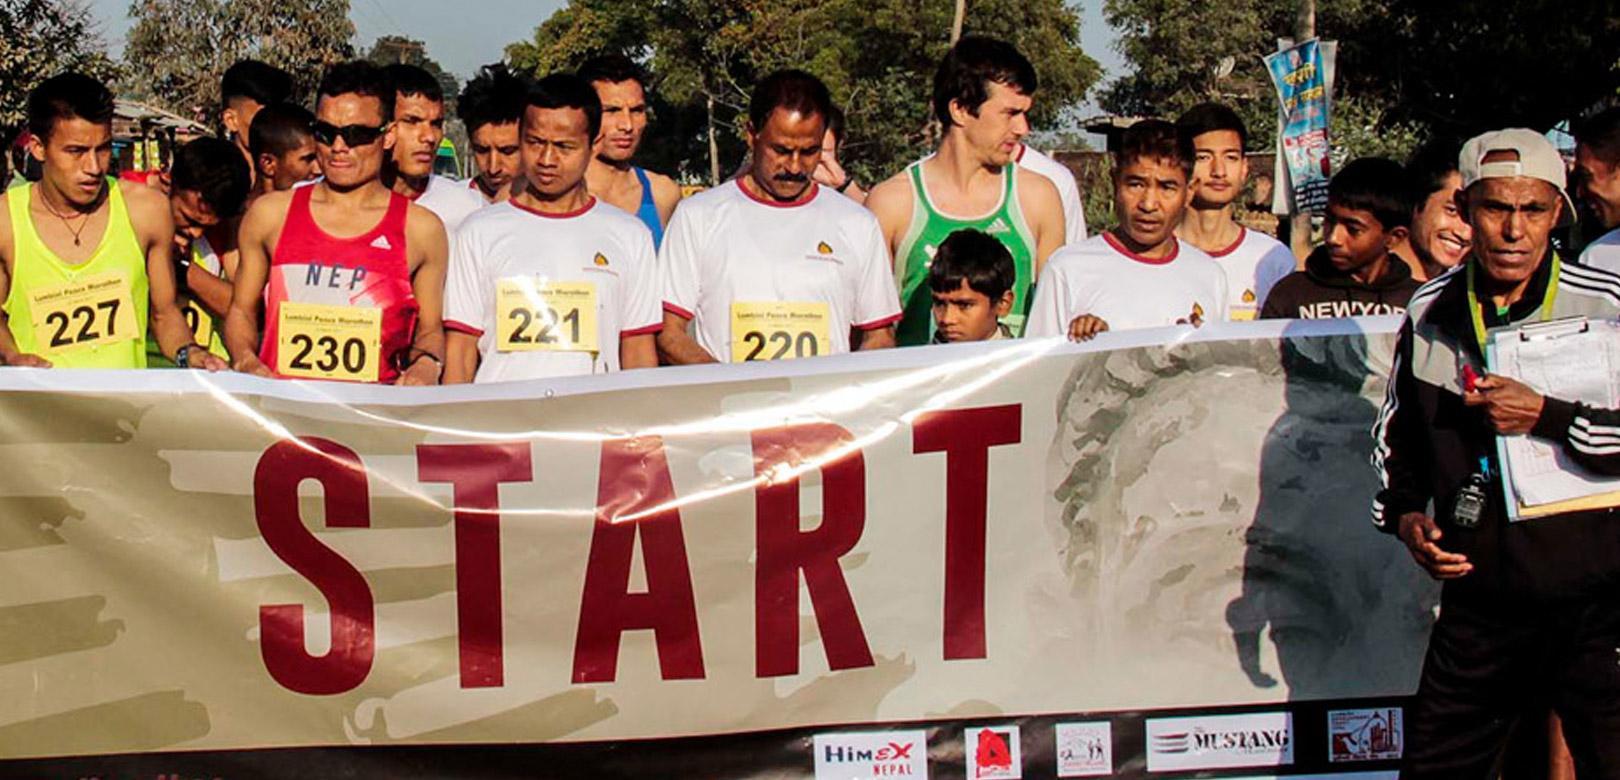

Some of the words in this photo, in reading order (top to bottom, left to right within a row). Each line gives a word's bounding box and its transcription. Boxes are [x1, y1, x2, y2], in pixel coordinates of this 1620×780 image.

[305, 261, 368, 290] NEP
[46, 298, 121, 348] 227
[508, 307, 580, 344] 221
[289, 333, 366, 374] 230
[743, 330, 818, 361] 220
[253, 402, 1022, 696] START
[1194, 728, 1289, 751] MUSTANG
[873, 763, 913, 776] NEPAL
